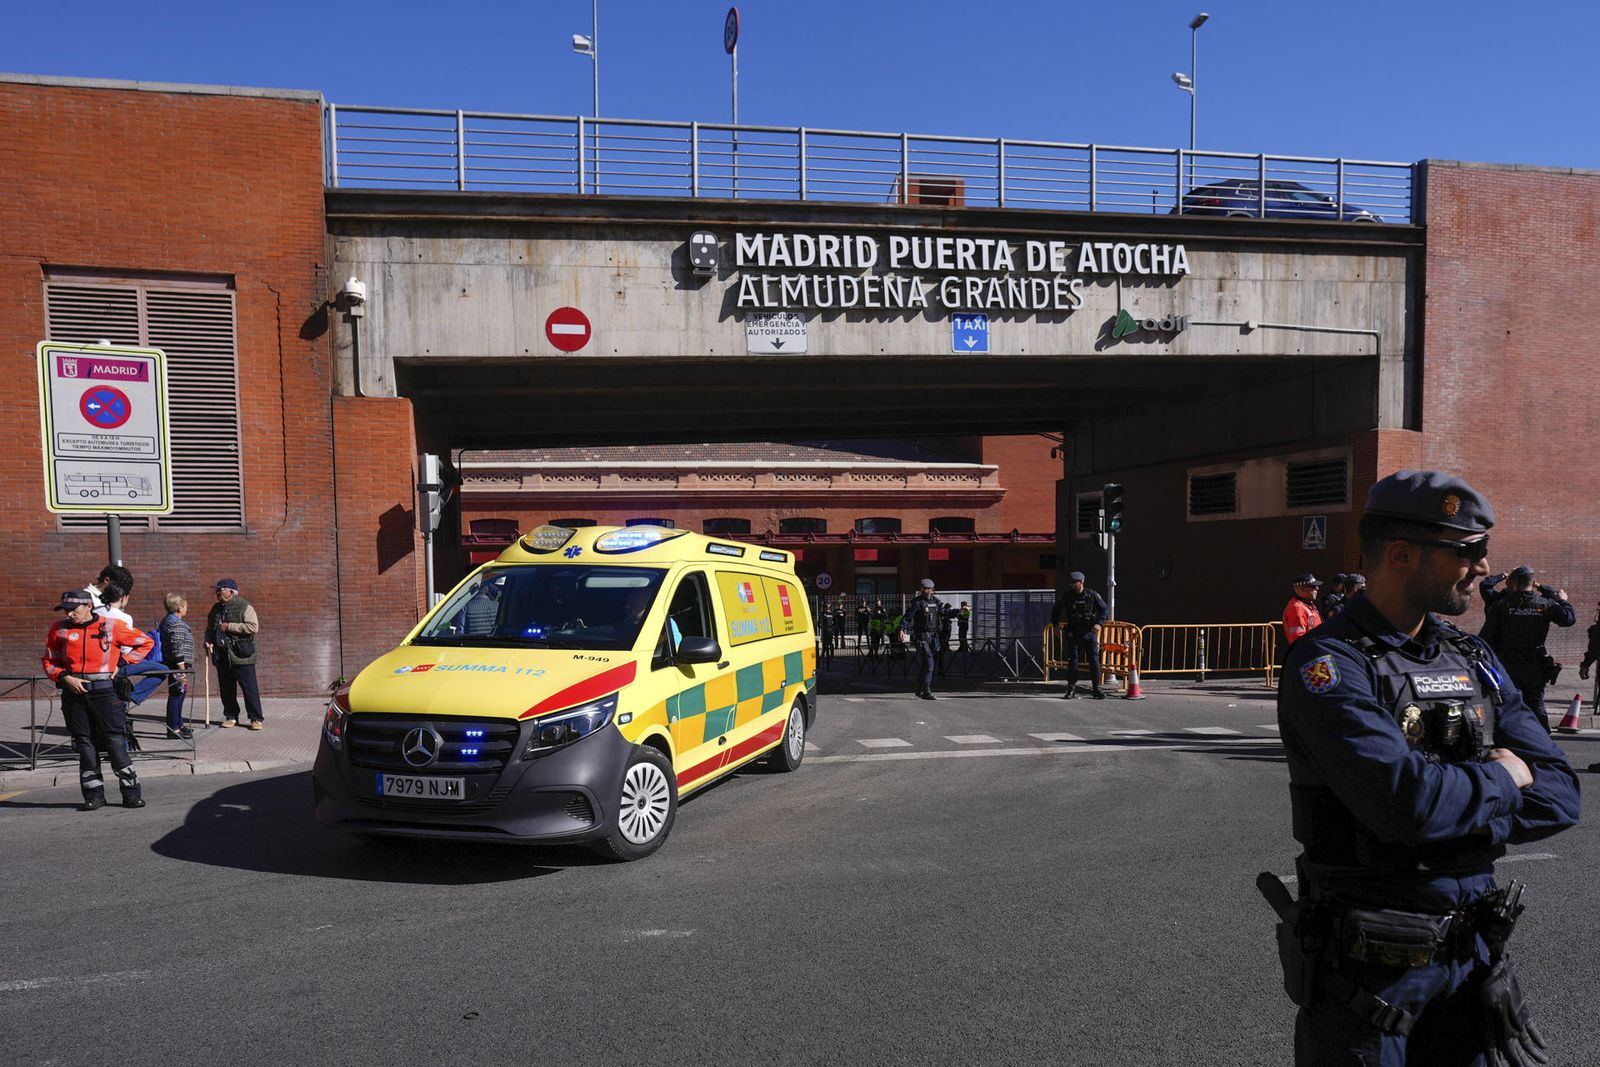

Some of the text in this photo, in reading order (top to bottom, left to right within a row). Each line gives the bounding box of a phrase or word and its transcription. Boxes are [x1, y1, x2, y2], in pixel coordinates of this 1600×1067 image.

[735, 232, 1192, 275] MADRID PUERTA DE ATOCHA
[737, 274, 1084, 310] ALMUDENA GRANDES
[747, 320, 800, 328] EMERGENCIA
[954, 318, 986, 330] TAXI
[1141, 314, 1192, 331] adif
[93, 365, 138, 376] MADRID
[817, 576, 830, 585] 20
[731, 618, 758, 638] SUMMA
[572, 654, 610, 663] M-949
[433, 664, 546, 677] SUMMA 112
[1416, 683, 1474, 693] NACIONAL
[386, 777, 460, 796] 7979 NJM
